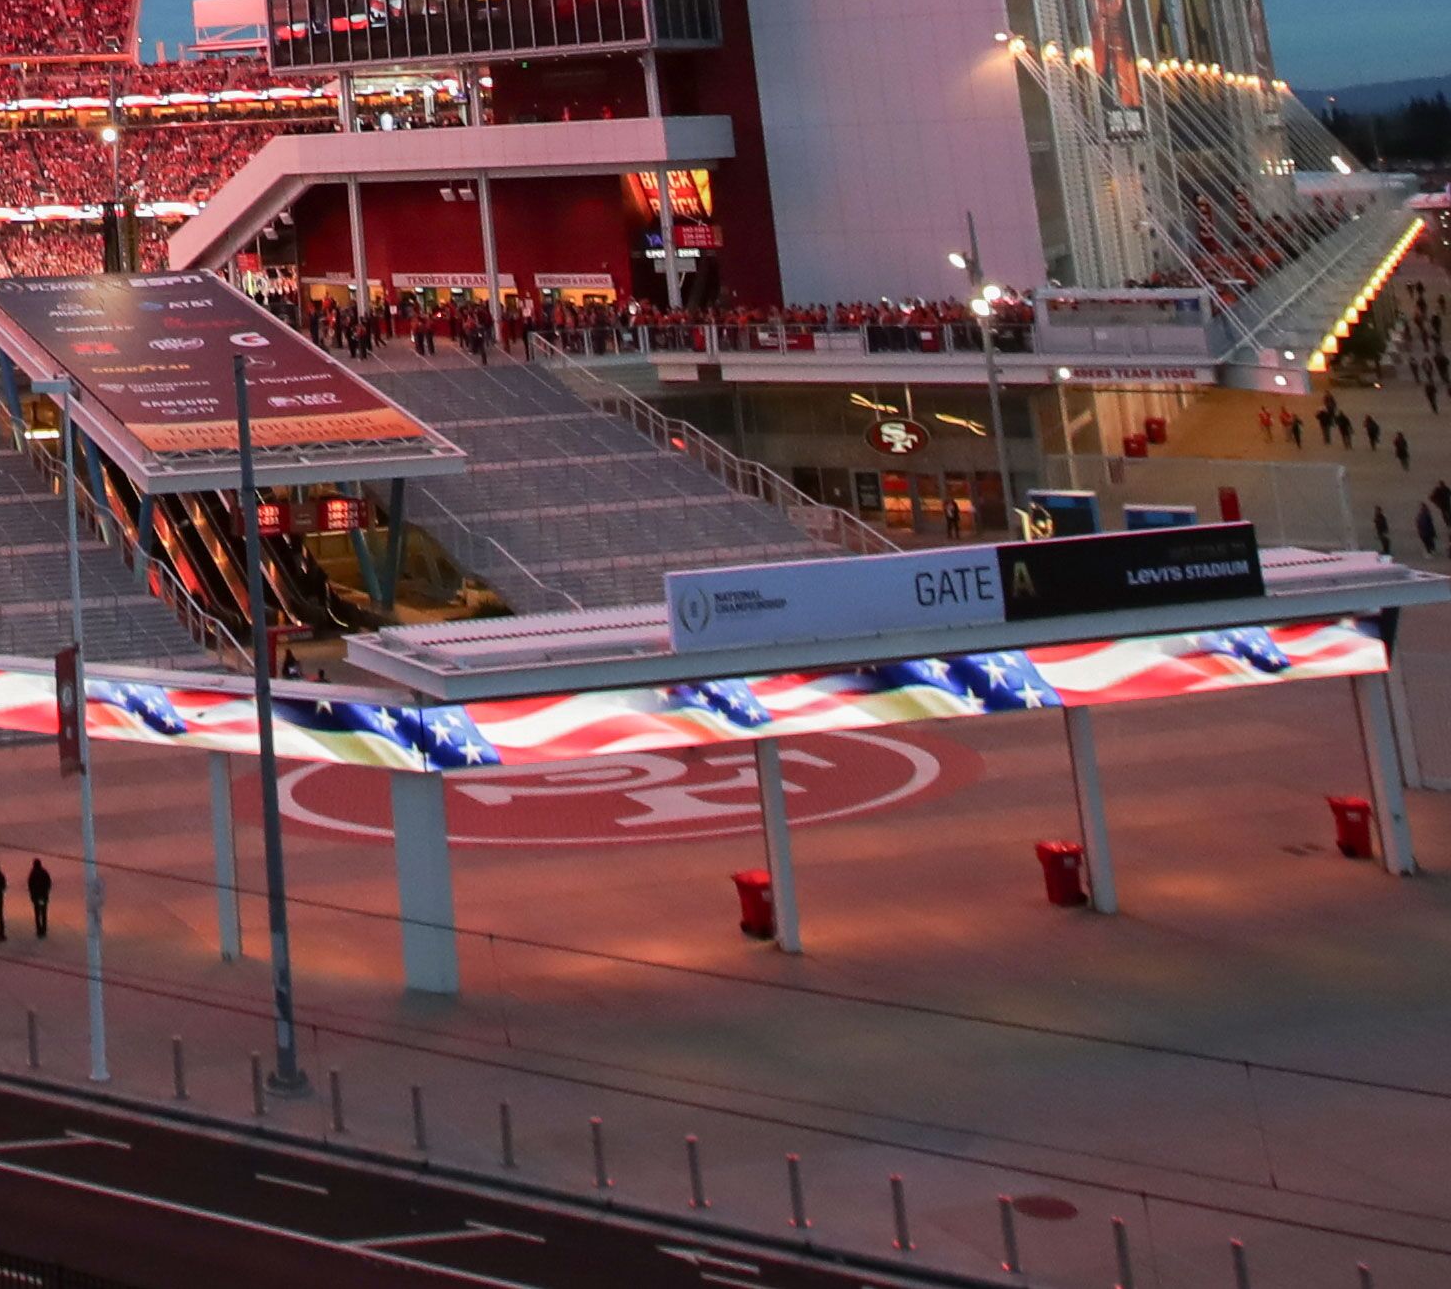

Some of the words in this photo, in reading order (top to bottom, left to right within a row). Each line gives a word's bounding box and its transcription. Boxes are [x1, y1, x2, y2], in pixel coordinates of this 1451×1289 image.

[128, 274, 204, 288] ESPN
[407, 276, 449, 286] TENDERS
[168, 299, 214, 309] AT&T
[1116, 369, 1152, 379] TEAM
[1157, 369, 1197, 380] STORE
[140, 396, 220, 408] SAMSUNG
[1185, 560, 1249, 581] STADIUM
[914, 565, 995, 607] GATE
[1013, 561, 1036, 598] A
[714, 589, 761, 603] NATIONAL
[714, 597, 788, 614] CHAMPIONSHIP
